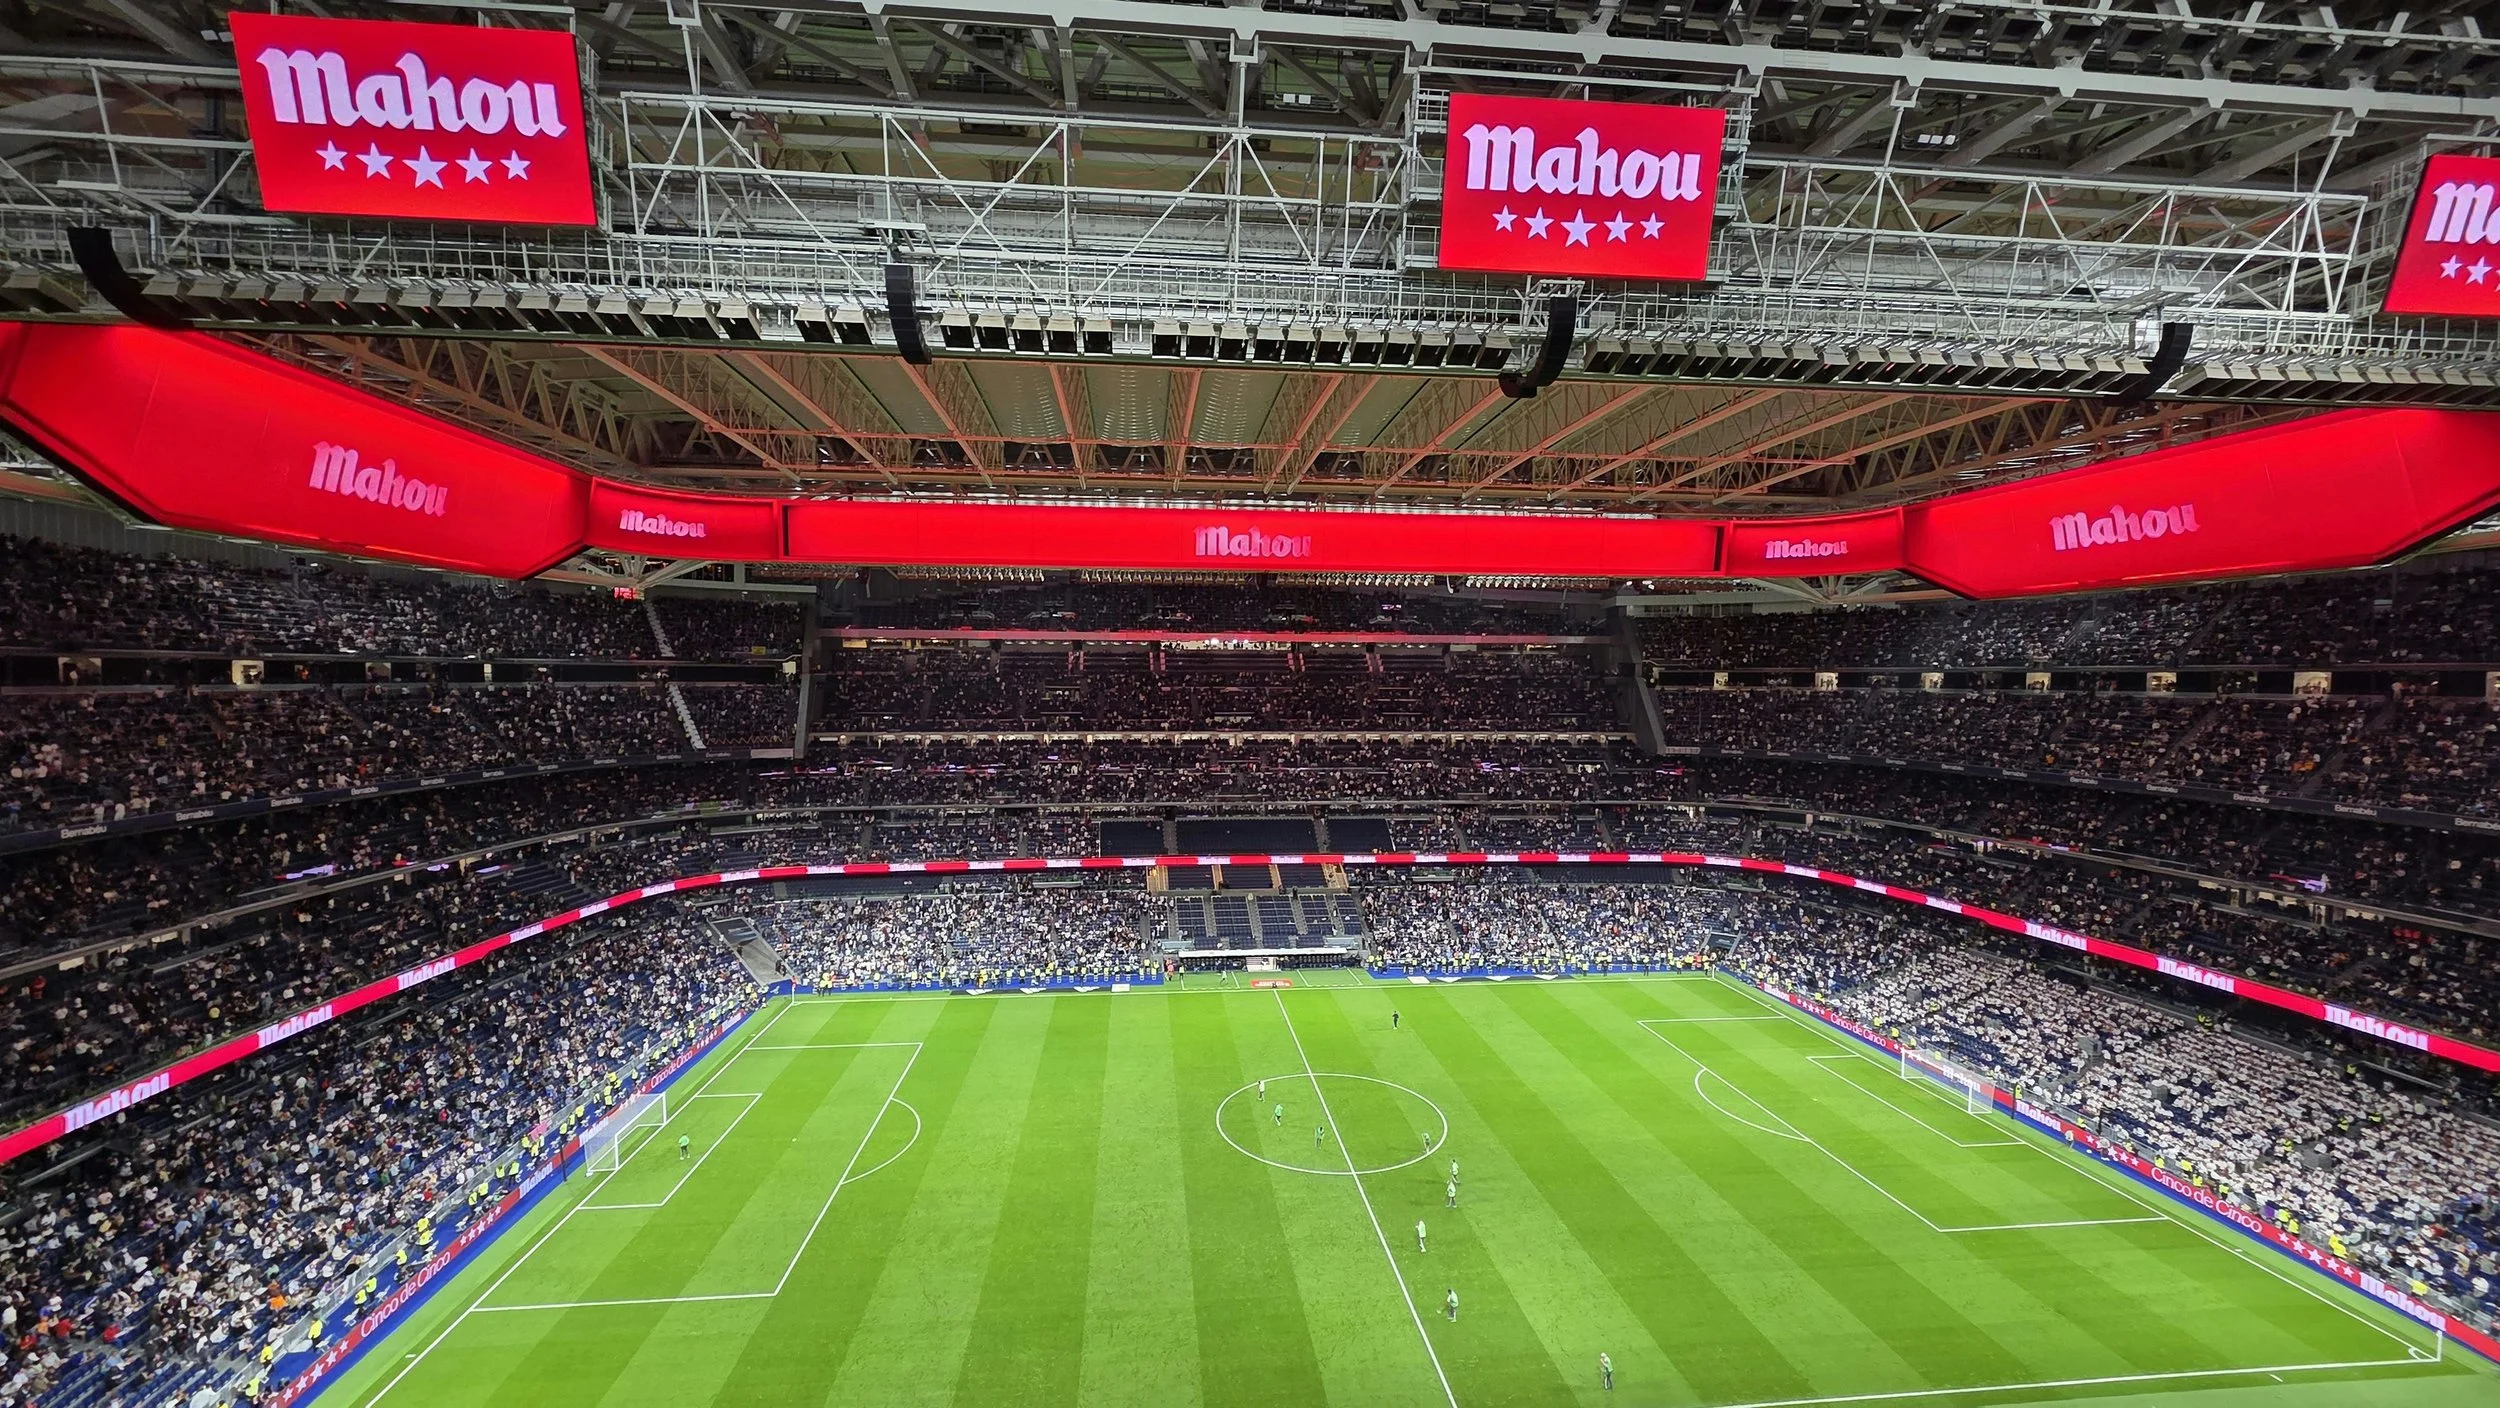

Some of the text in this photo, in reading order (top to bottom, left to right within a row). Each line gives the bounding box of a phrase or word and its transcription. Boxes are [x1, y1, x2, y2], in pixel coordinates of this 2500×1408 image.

[256, 47, 567, 138] Mahou
[1462, 123, 1702, 201] Mahou
[309, 440, 449, 516] Mahou
[620, 508, 706, 538] Mahou
[1193, 525, 1311, 558] Mahou
[2049, 503, 2201, 551] Mahou
[1765, 539, 1849, 559] Mahou
[2157, 957, 2234, 993] Mahou
[257, 1005, 332, 1049] Mahou
[1831, 1013, 1886, 1047] Cinco de Cinco
[2325, 1004, 2428, 1051] Mahou
[65, 1072, 169, 1133] Mahou
[2015, 1099, 2061, 1131] Mahou
[2151, 1167, 2262, 1233] Cinco de Cinco
[361, 1251, 450, 1337] Cinco de Cinco
[2360, 1272, 2446, 1331] Mahou
